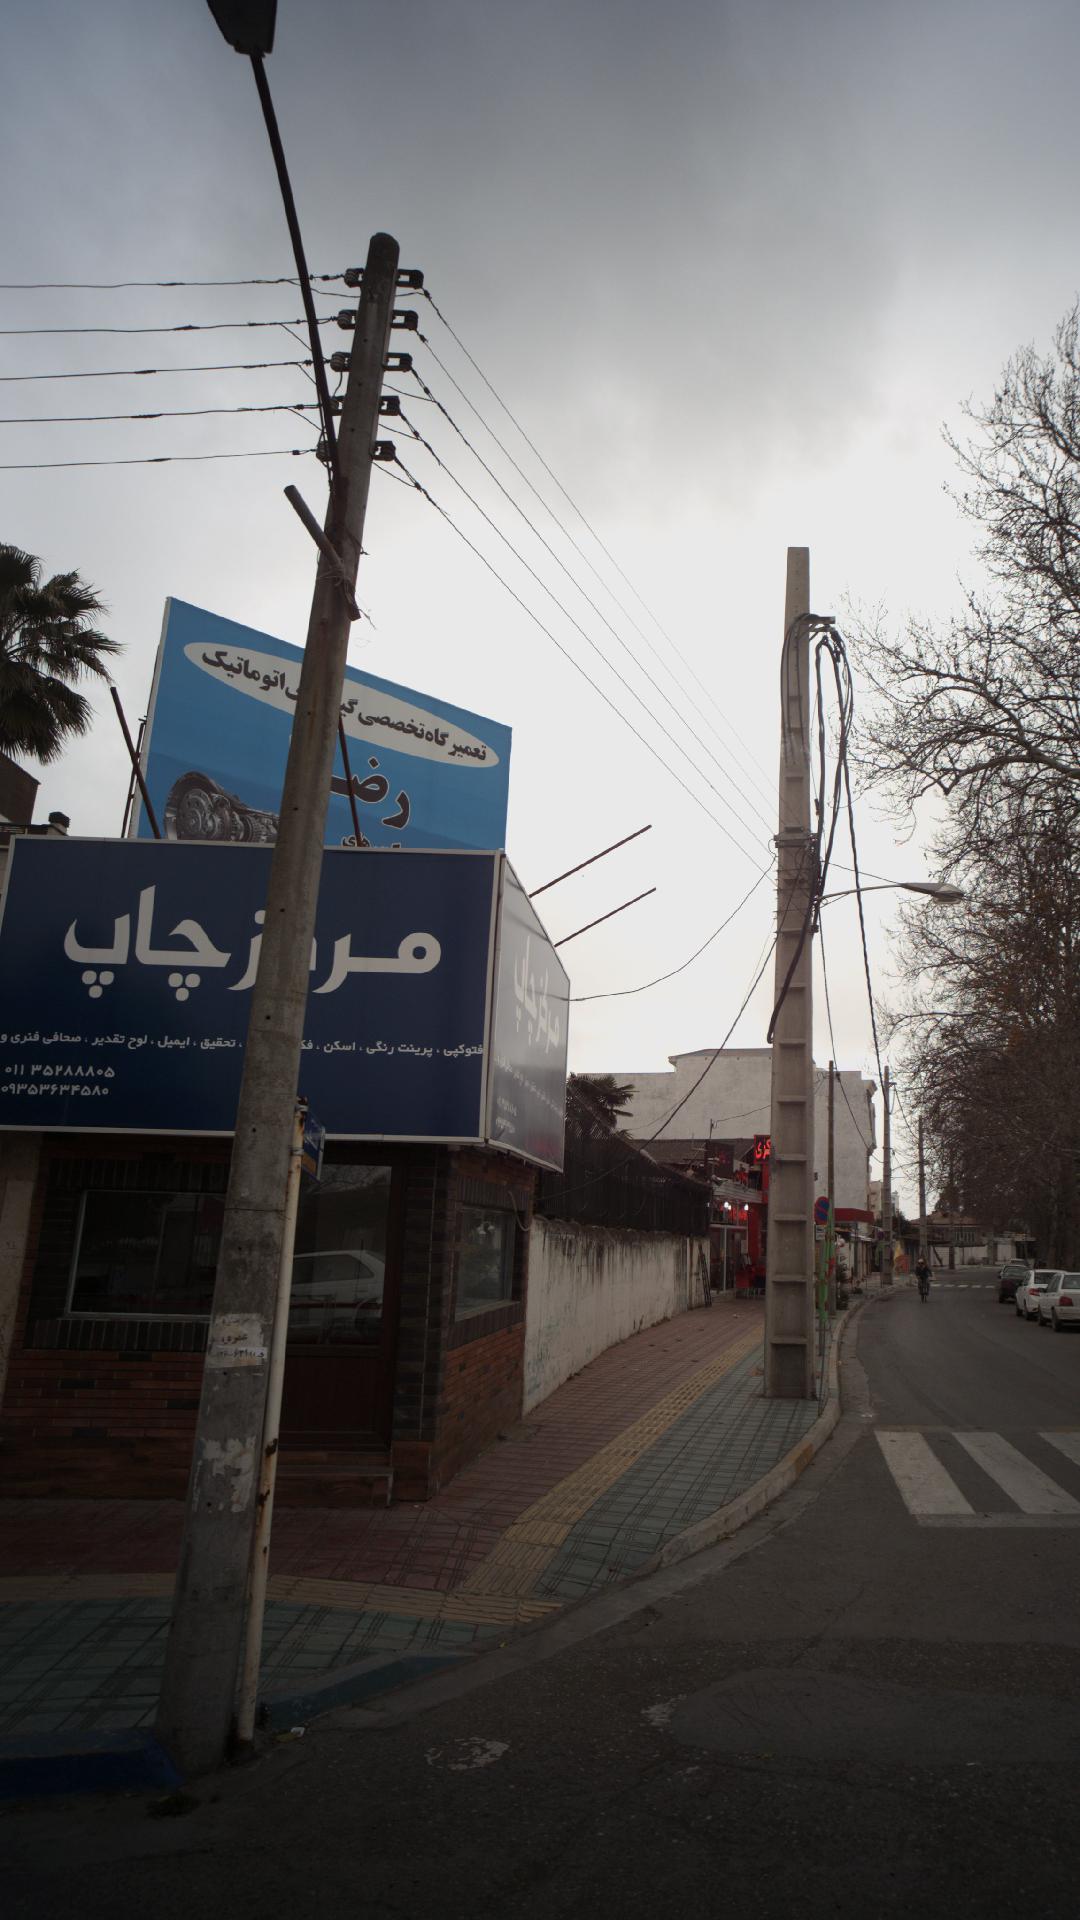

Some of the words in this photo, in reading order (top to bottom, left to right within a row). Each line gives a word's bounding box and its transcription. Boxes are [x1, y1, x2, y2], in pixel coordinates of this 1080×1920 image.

[202, 651, 286, 691] اتوماتیک
[63, 884, 231, 1002] چاپ
[10, 1031, 40, 1044] فنری
[91, 1032, 126, 1046] تقدیر
[127, 1034, 148, 1050] لوح
[157, 1036, 191, 1049] ایمیل
[323, 1041, 356, 1053] اسکن
[366, 1041, 394, 1055] رنگی
[397, 1042, 433, 1059] پرینت
